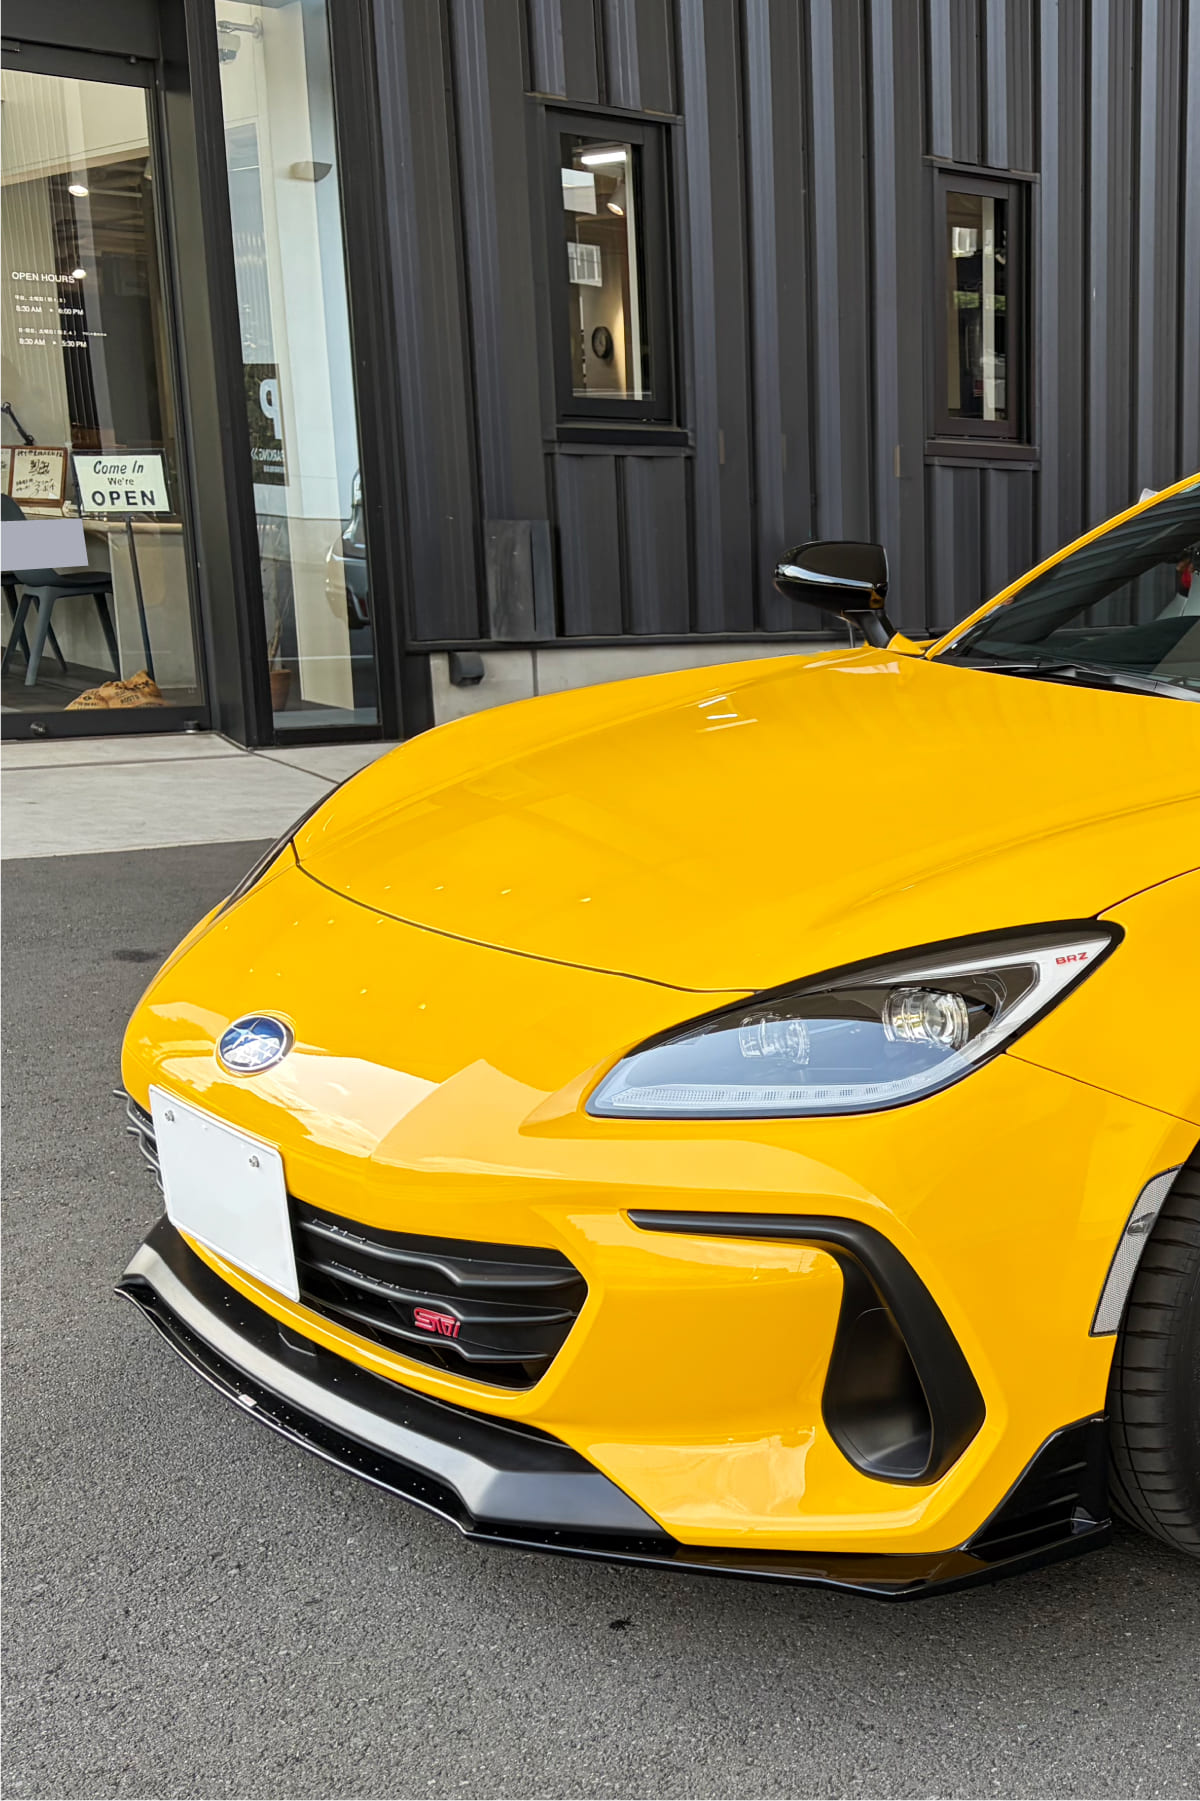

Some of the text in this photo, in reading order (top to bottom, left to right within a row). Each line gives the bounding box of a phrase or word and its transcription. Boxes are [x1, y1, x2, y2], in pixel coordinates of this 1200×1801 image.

[11, 271, 75, 284] OPEN HOURS
[34, 338, 46, 346] AM
[93, 460, 144, 475] Come In
[107, 477, 135, 486] We're
[91, 490, 156, 507] OPEN
[1055, 952, 1088, 965] BRZ
